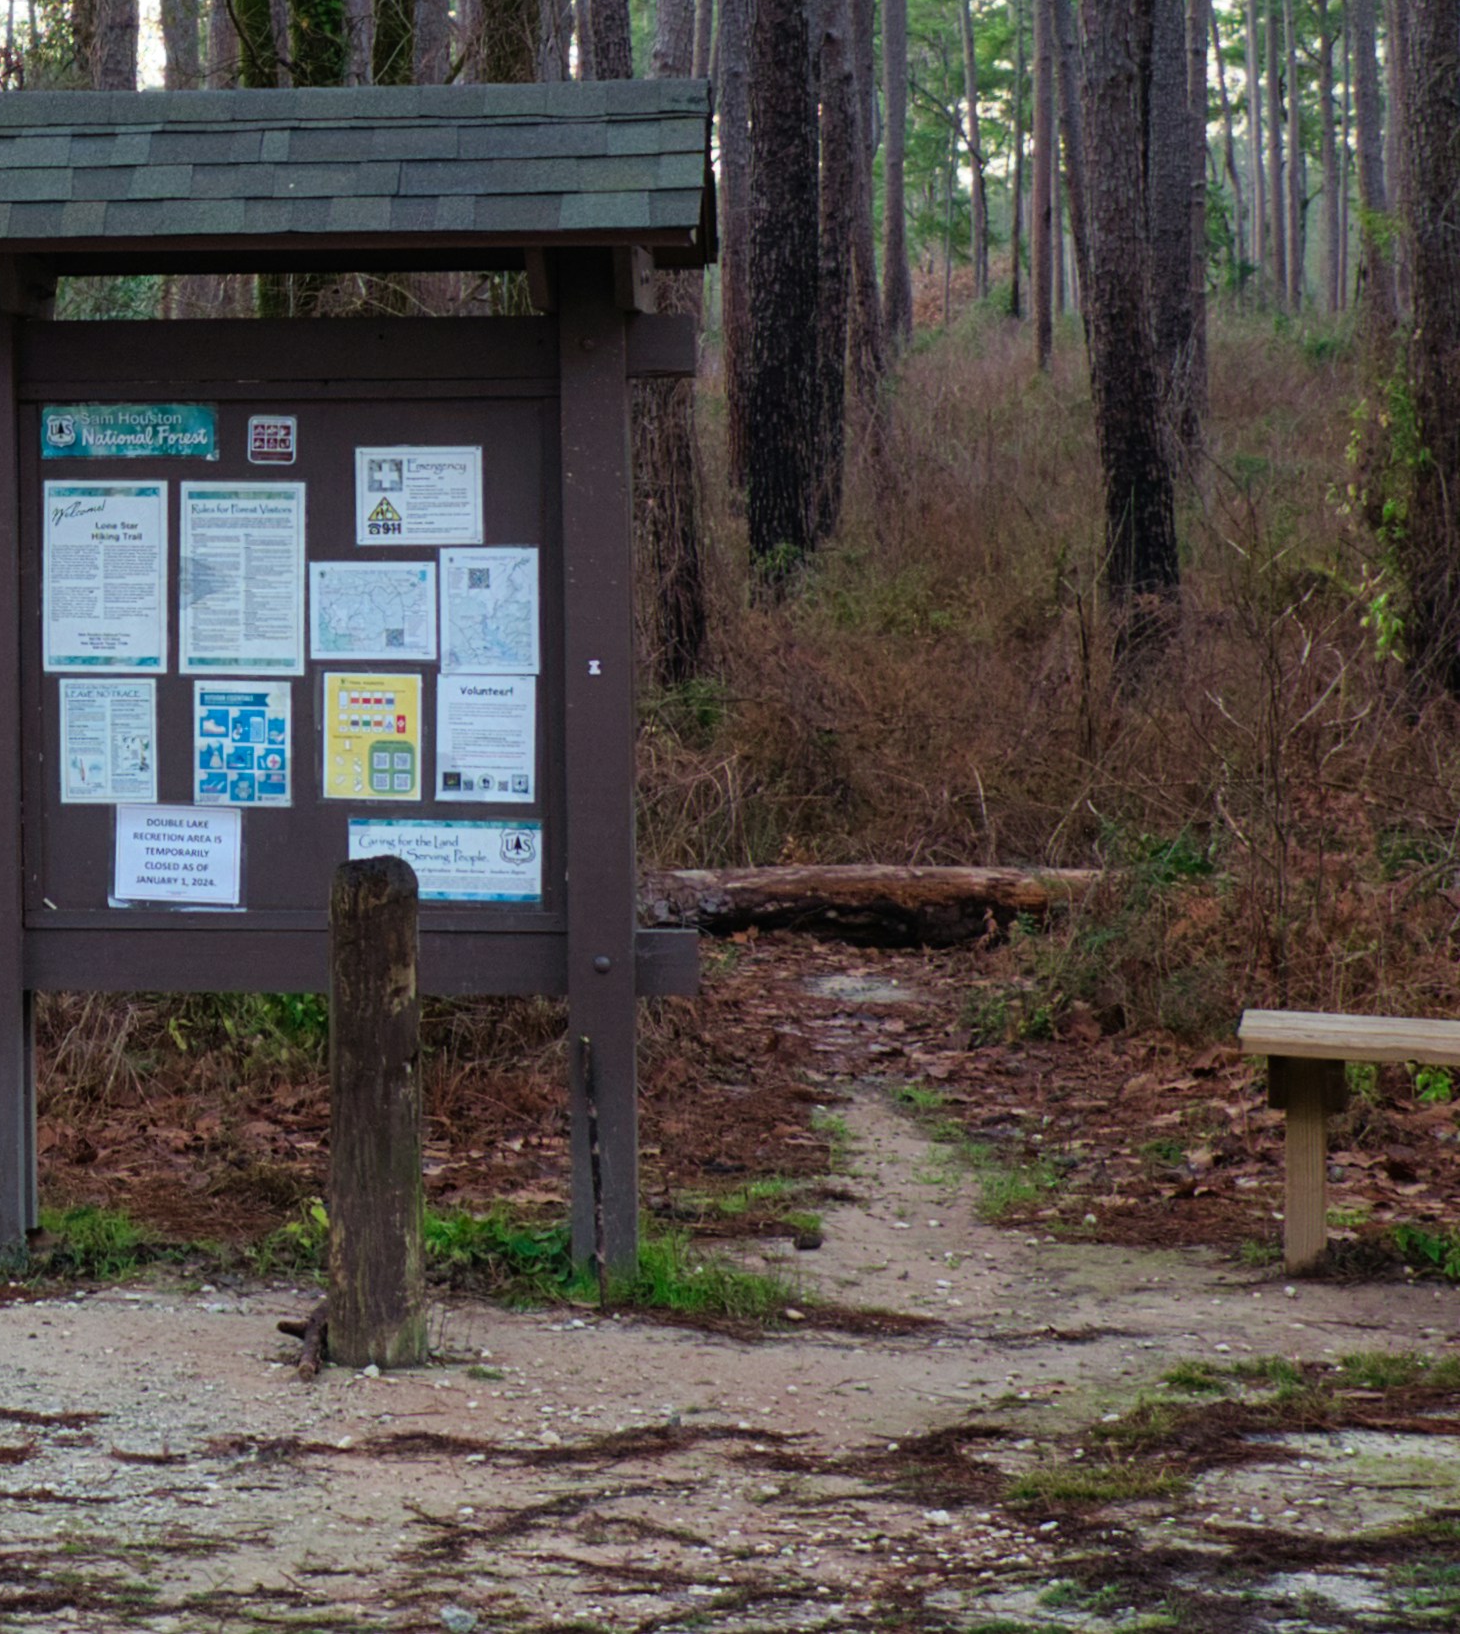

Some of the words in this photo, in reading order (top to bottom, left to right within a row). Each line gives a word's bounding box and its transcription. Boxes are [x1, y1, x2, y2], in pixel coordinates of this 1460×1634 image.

[81, 412, 114, 426] Sam
[117, 412, 183, 426] Houston
[82, 426, 154, 447] National
[157, 425, 209, 446] Forest
[407, 458, 467, 475] Emergency
[191, 503, 215, 515] Rules
[217, 503, 229, 515] for
[231, 503, 257, 515] Forest
[258, 503, 293, 515] Visitors
[95, 521, 118, 531] Lone
[120, 521, 139, 531] Star
[91, 531, 120, 542] Hiking
[123, 531, 143, 541] Trail
[460, 686, 513, 697] Volunteer!
[146, 818, 184, 828] DOUBLE
[186, 819, 209, 829] LAKE
[133, 832, 185, 843] RECRETION
[187, 834, 212, 844] AREA
[214, 835, 223, 844] IS
[359, 834, 397, 850] Caring
[397, 834, 412, 848] for
[415, 835, 432, 848] the
[434, 835, 460, 849] Land
[145, 847, 210, 858] TEMPORARILY
[406, 848, 451, 865] Serving
[453, 849, 489, 866] People.
[144, 861, 180, 871] CLOSED
[182, 863, 194, 872] AS
[196, 863, 210, 872] OF
[136, 875, 178, 885] JANUARY
[191, 877, 218, 887] 2024.
